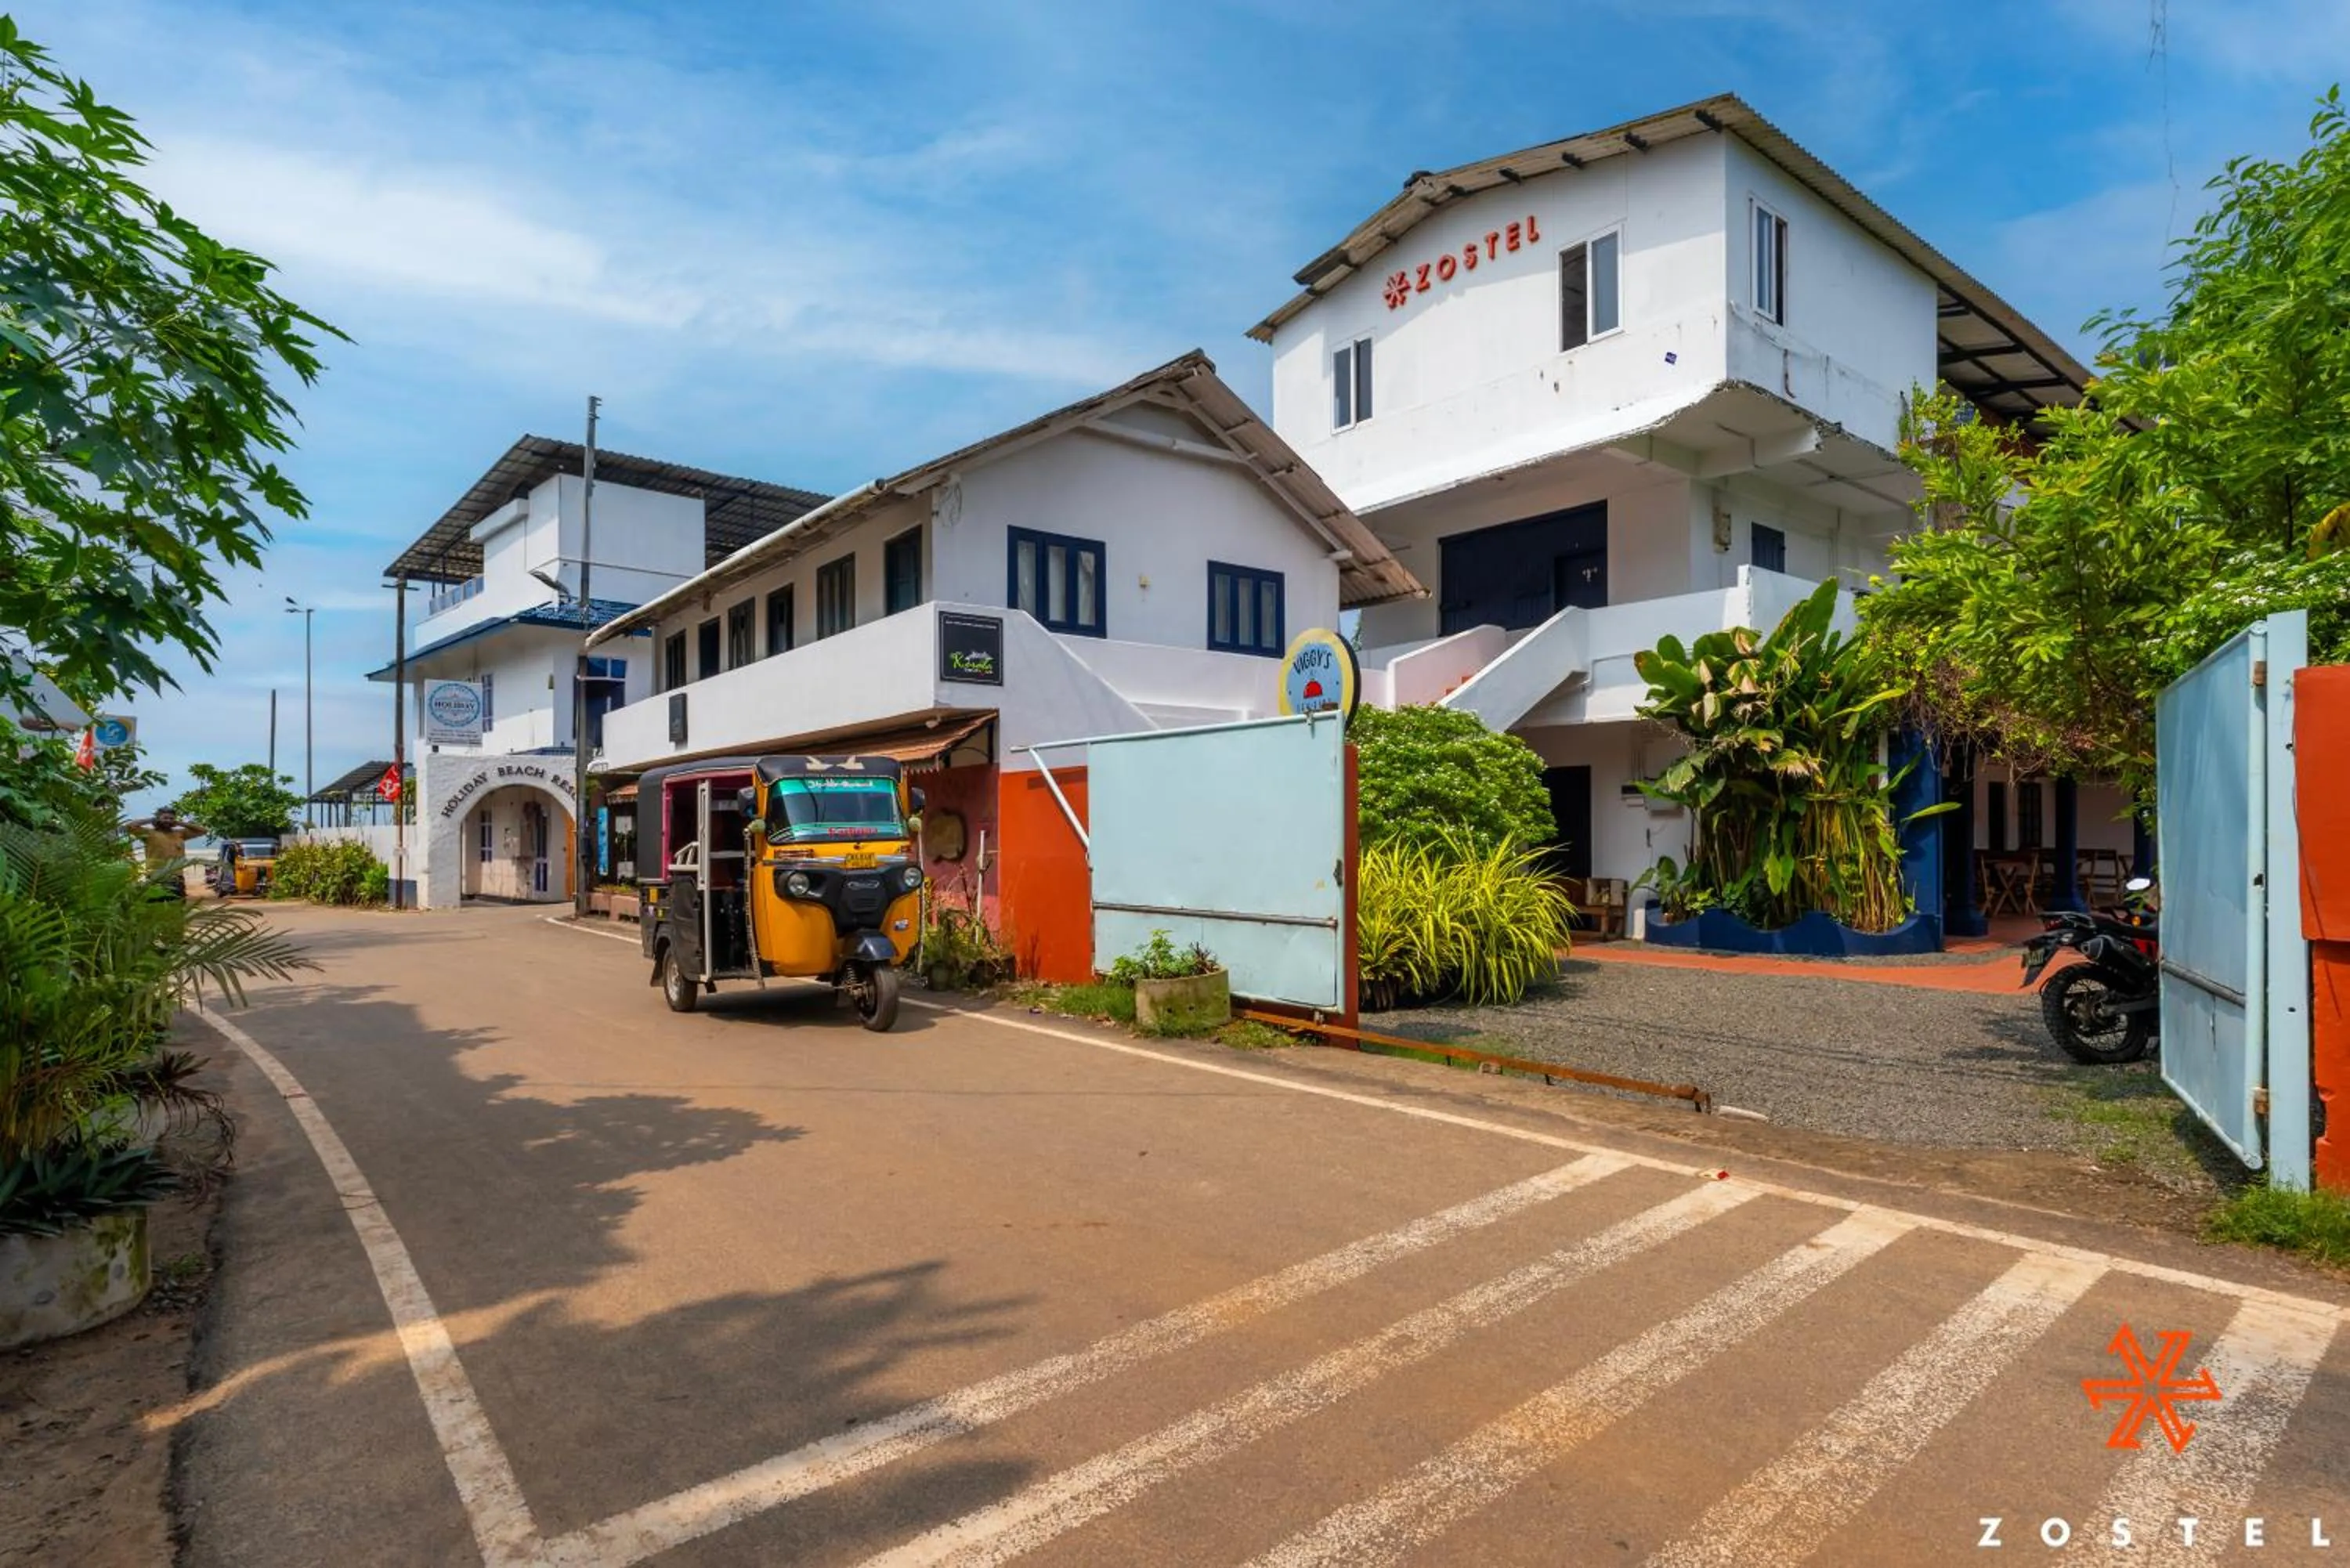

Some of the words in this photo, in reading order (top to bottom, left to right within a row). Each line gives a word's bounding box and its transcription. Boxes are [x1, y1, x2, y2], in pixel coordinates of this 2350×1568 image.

[1415, 215, 1541, 294] ZOSTEL
[1292, 648, 1332, 674] VIGGY'S
[434, 701, 475, 710] HOLIDAY
[441, 771, 488, 818] HOLIDAY
[497, 765, 546, 779] BEACH
